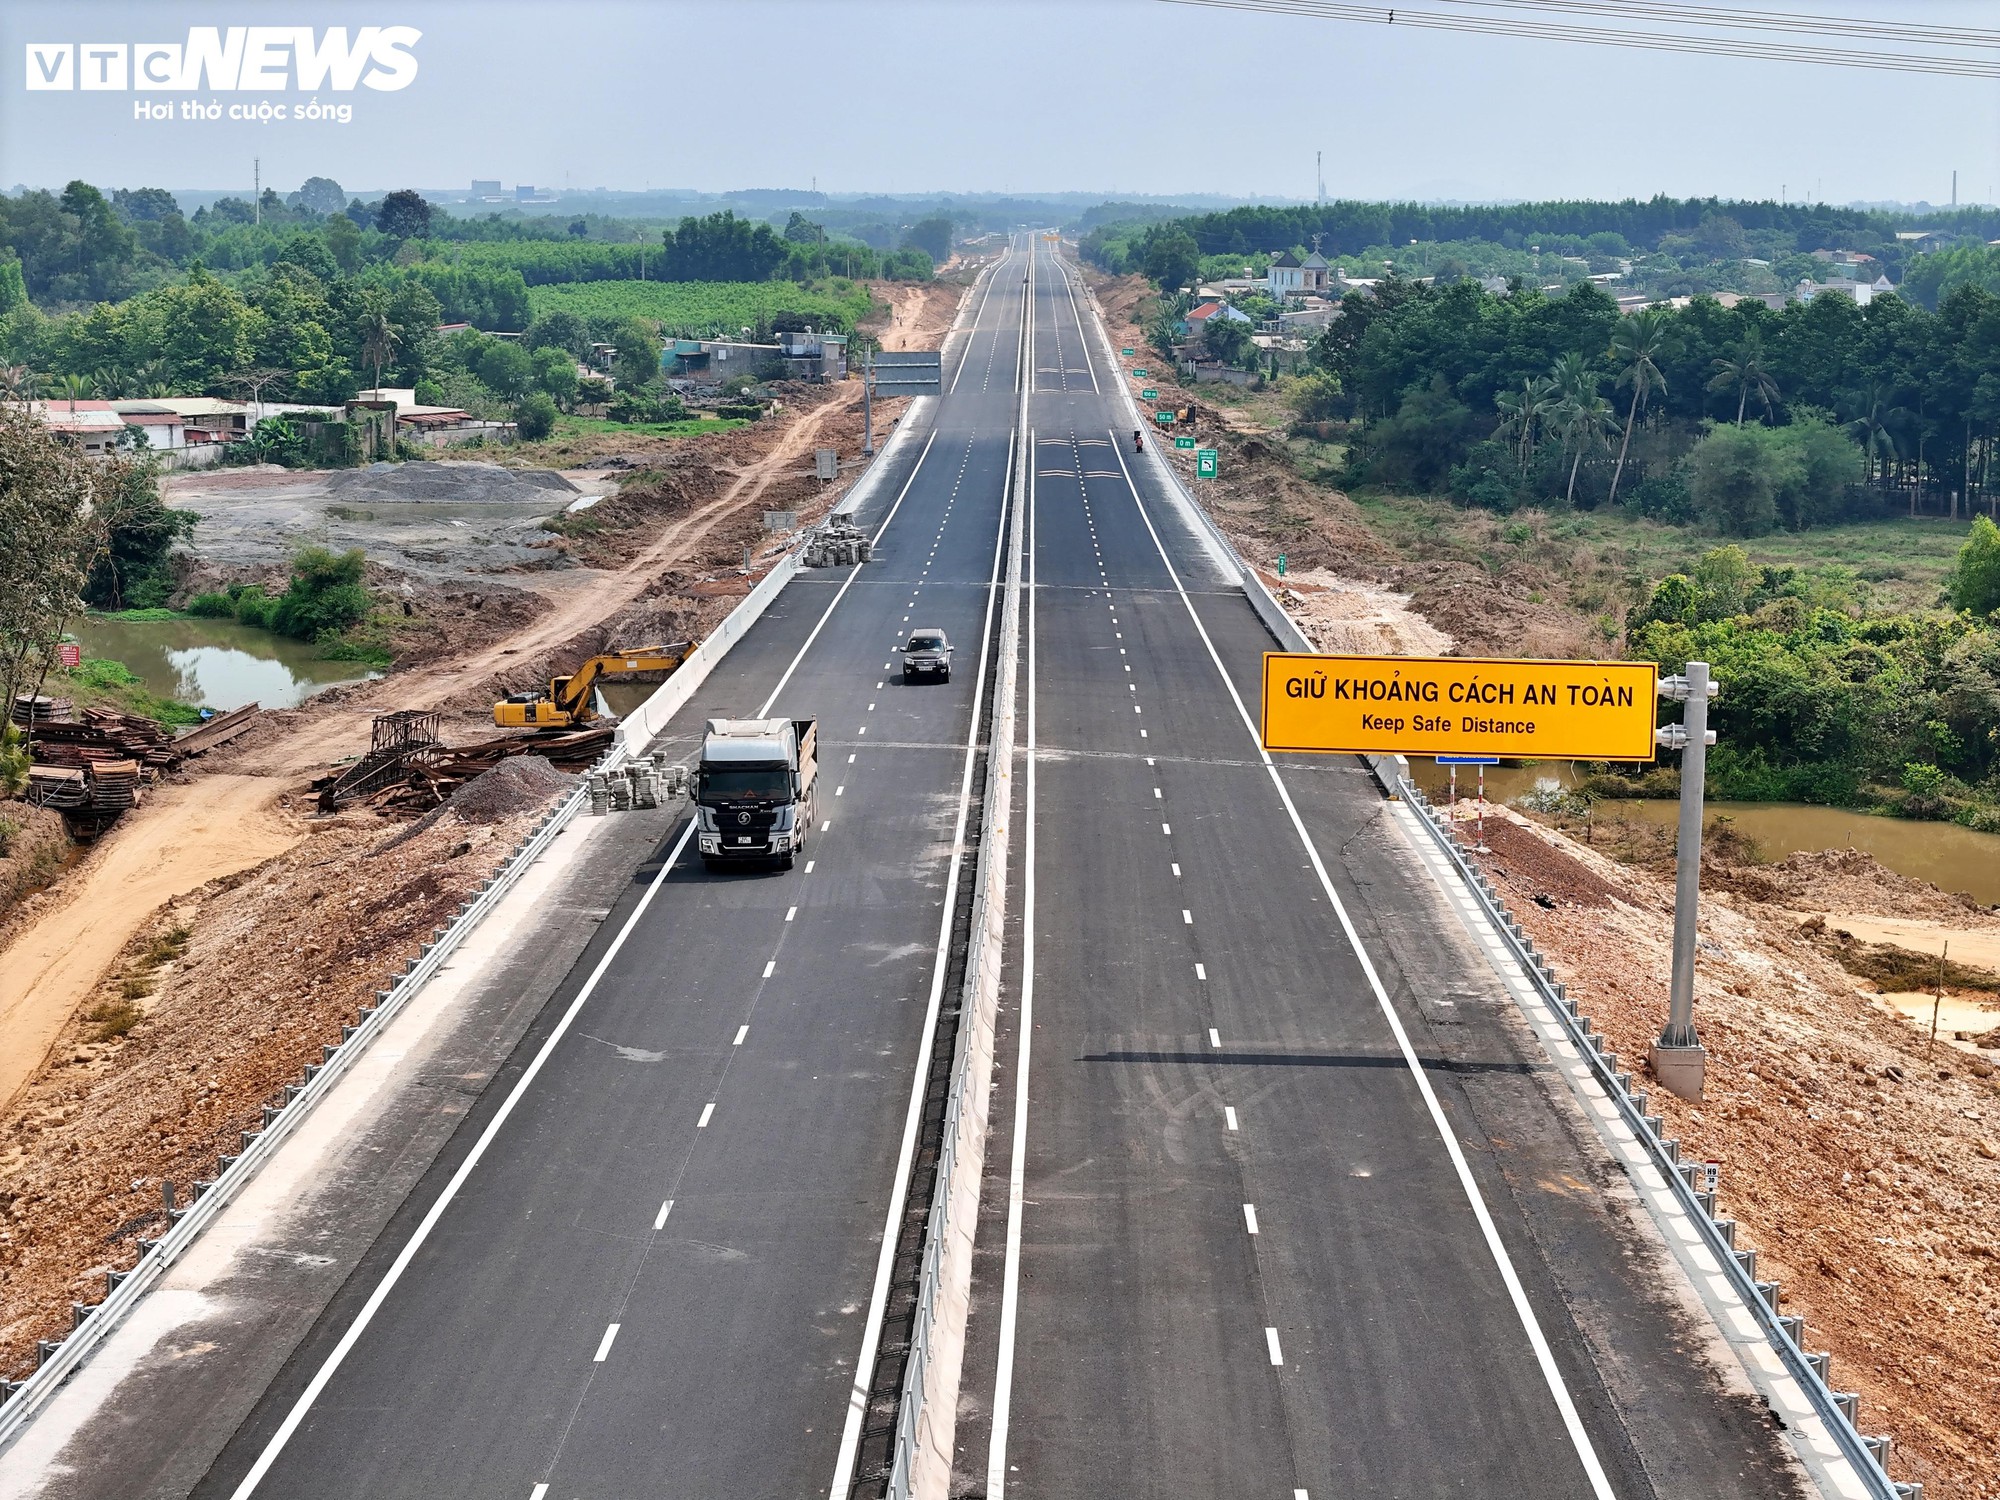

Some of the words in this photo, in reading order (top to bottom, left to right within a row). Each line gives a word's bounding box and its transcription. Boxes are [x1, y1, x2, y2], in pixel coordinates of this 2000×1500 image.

[1285, 670, 1328, 699] GIỮ
[1334, 670, 1439, 702] KHOẢNG
[1448, 675, 1514, 704] CÁCH
[1522, 683, 1557, 706] AN
[1566, 678, 1633, 707] TOÀN
[1361, 714, 1405, 734] Keep
[1412, 715, 1452, 732] Safe
[1461, 716, 1536, 734] Distance
